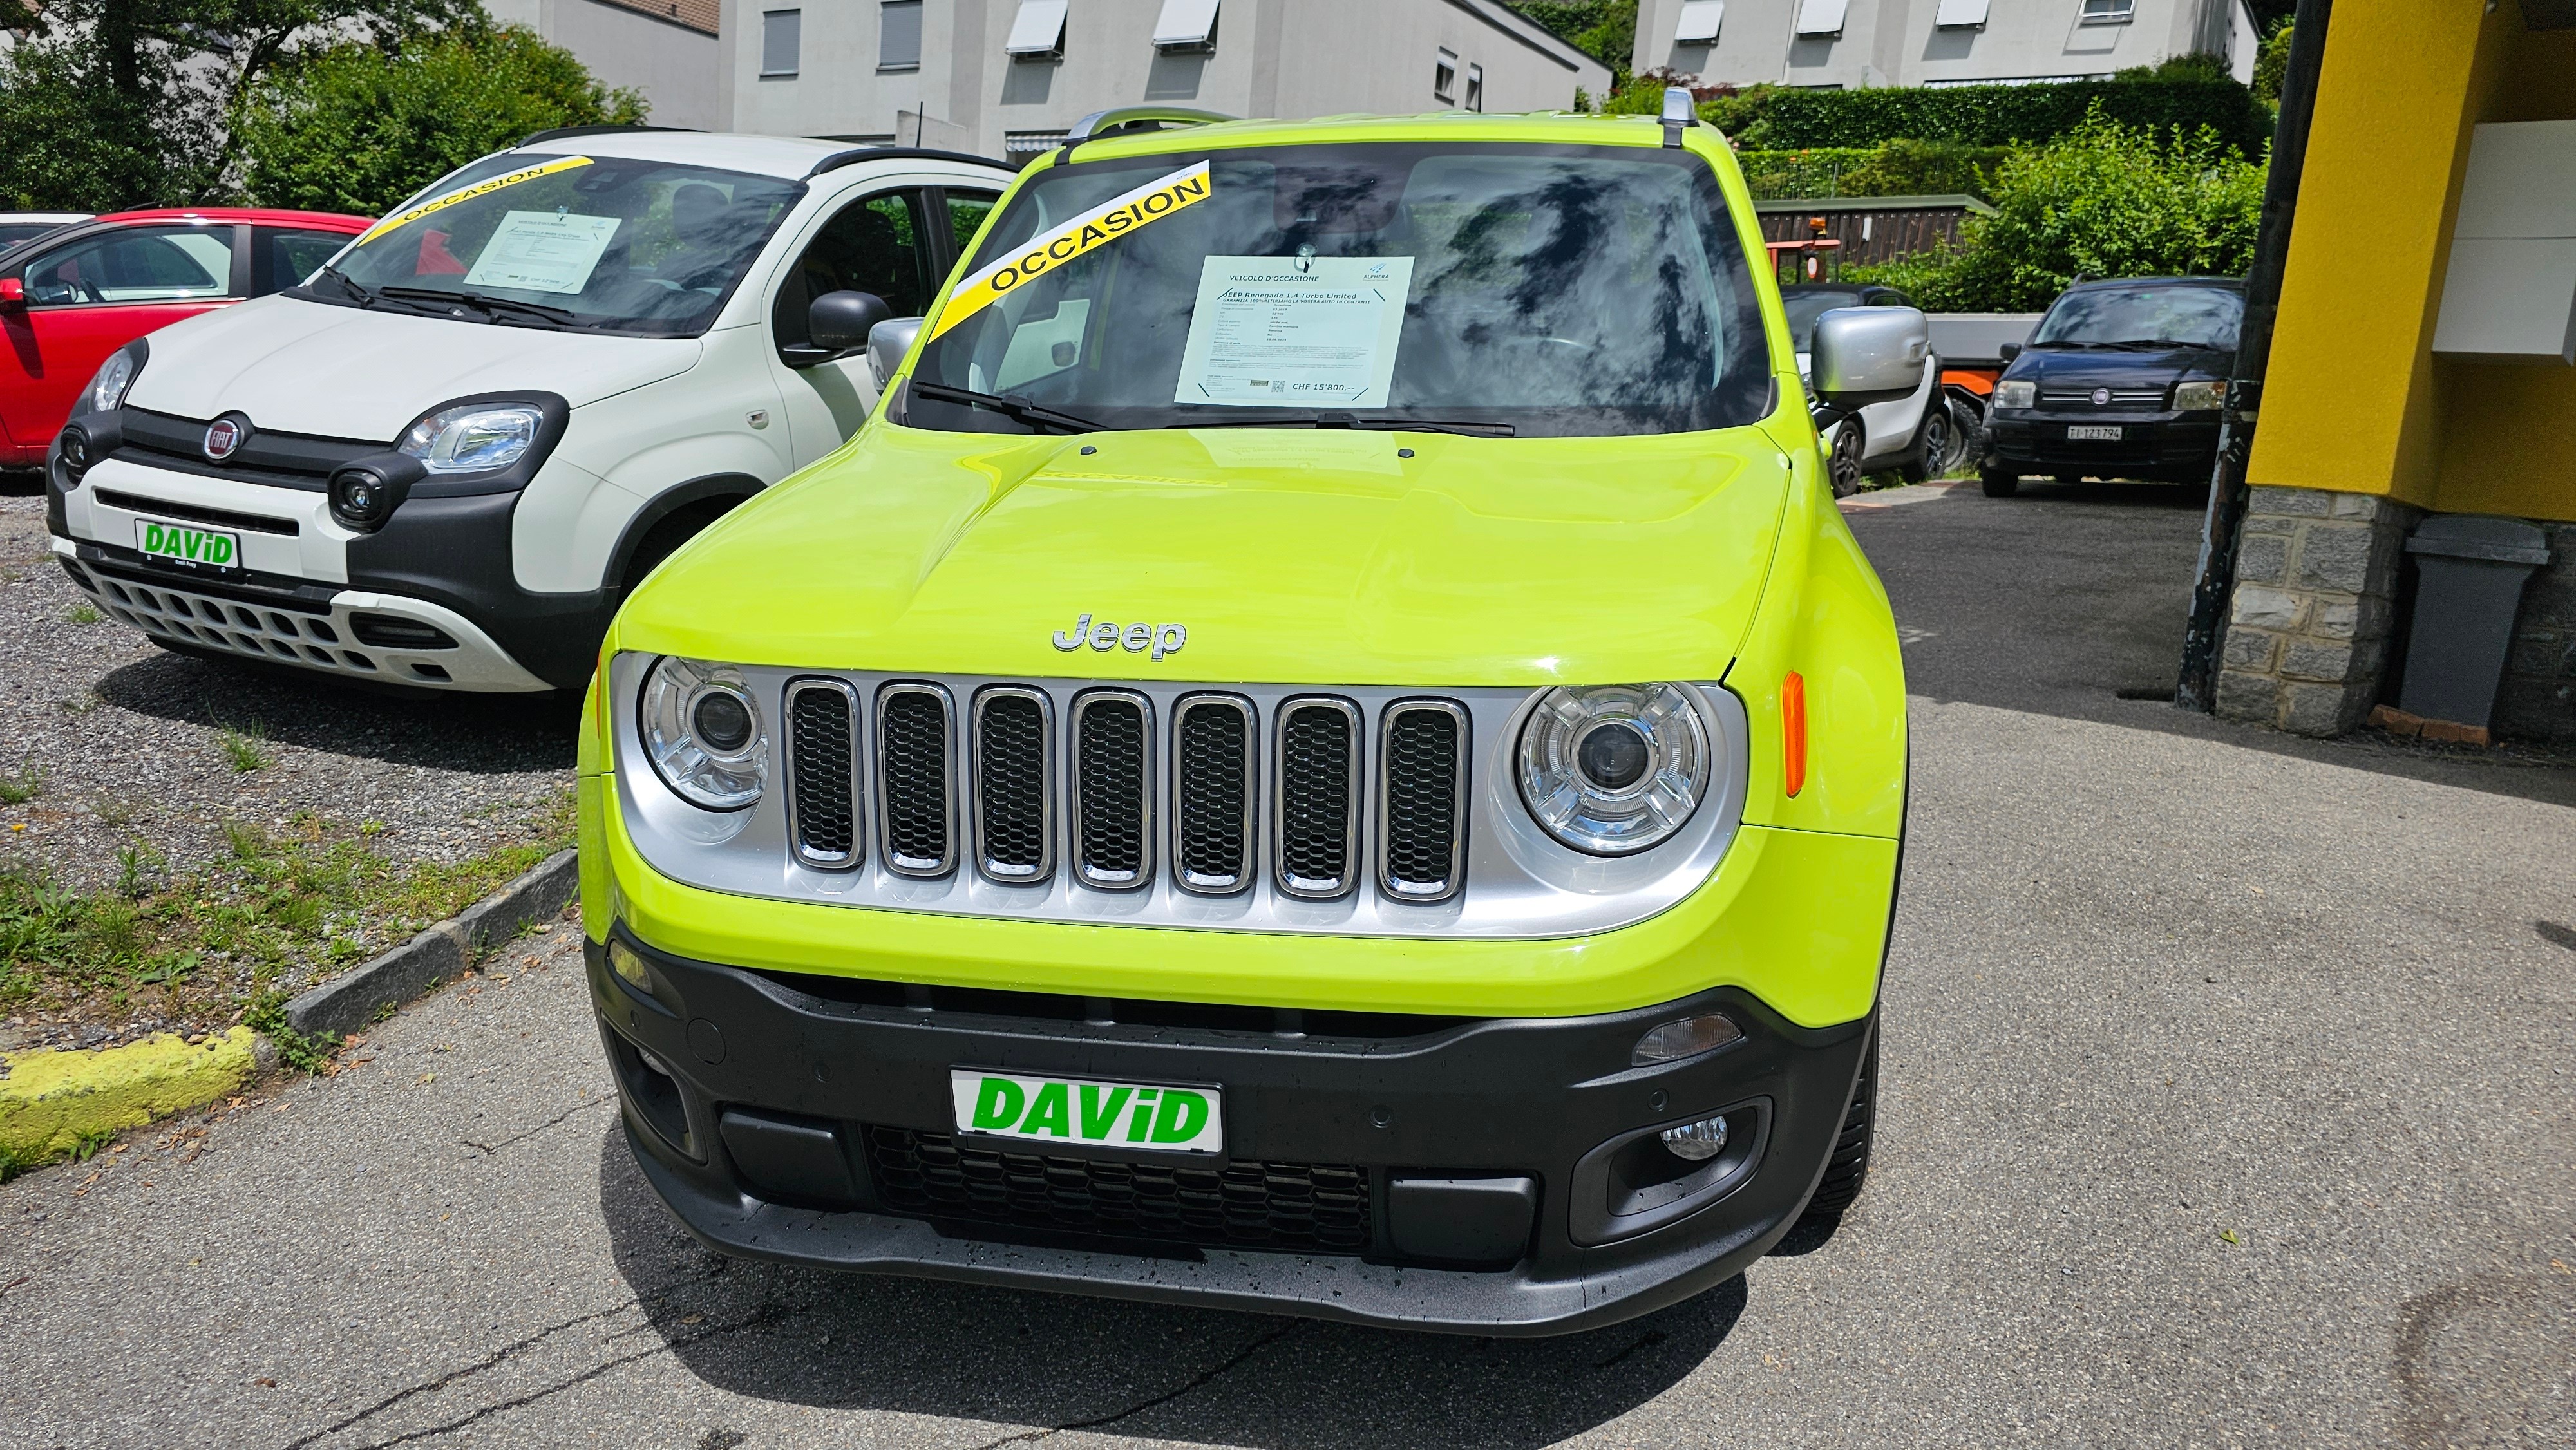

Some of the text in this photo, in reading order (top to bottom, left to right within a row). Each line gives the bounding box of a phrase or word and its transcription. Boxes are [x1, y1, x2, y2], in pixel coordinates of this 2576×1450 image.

[404, 168, 544, 221] OCCASION
[991, 178, 1204, 292] OCCASION
[1313, 383, 1356, 391] 15'800.--
[209, 431, 232, 449] FIAT
[144, 524, 232, 564] DAViD
[1052, 614, 1187, 662] Jeep
[972, 1077, 1209, 1144] DAViD
